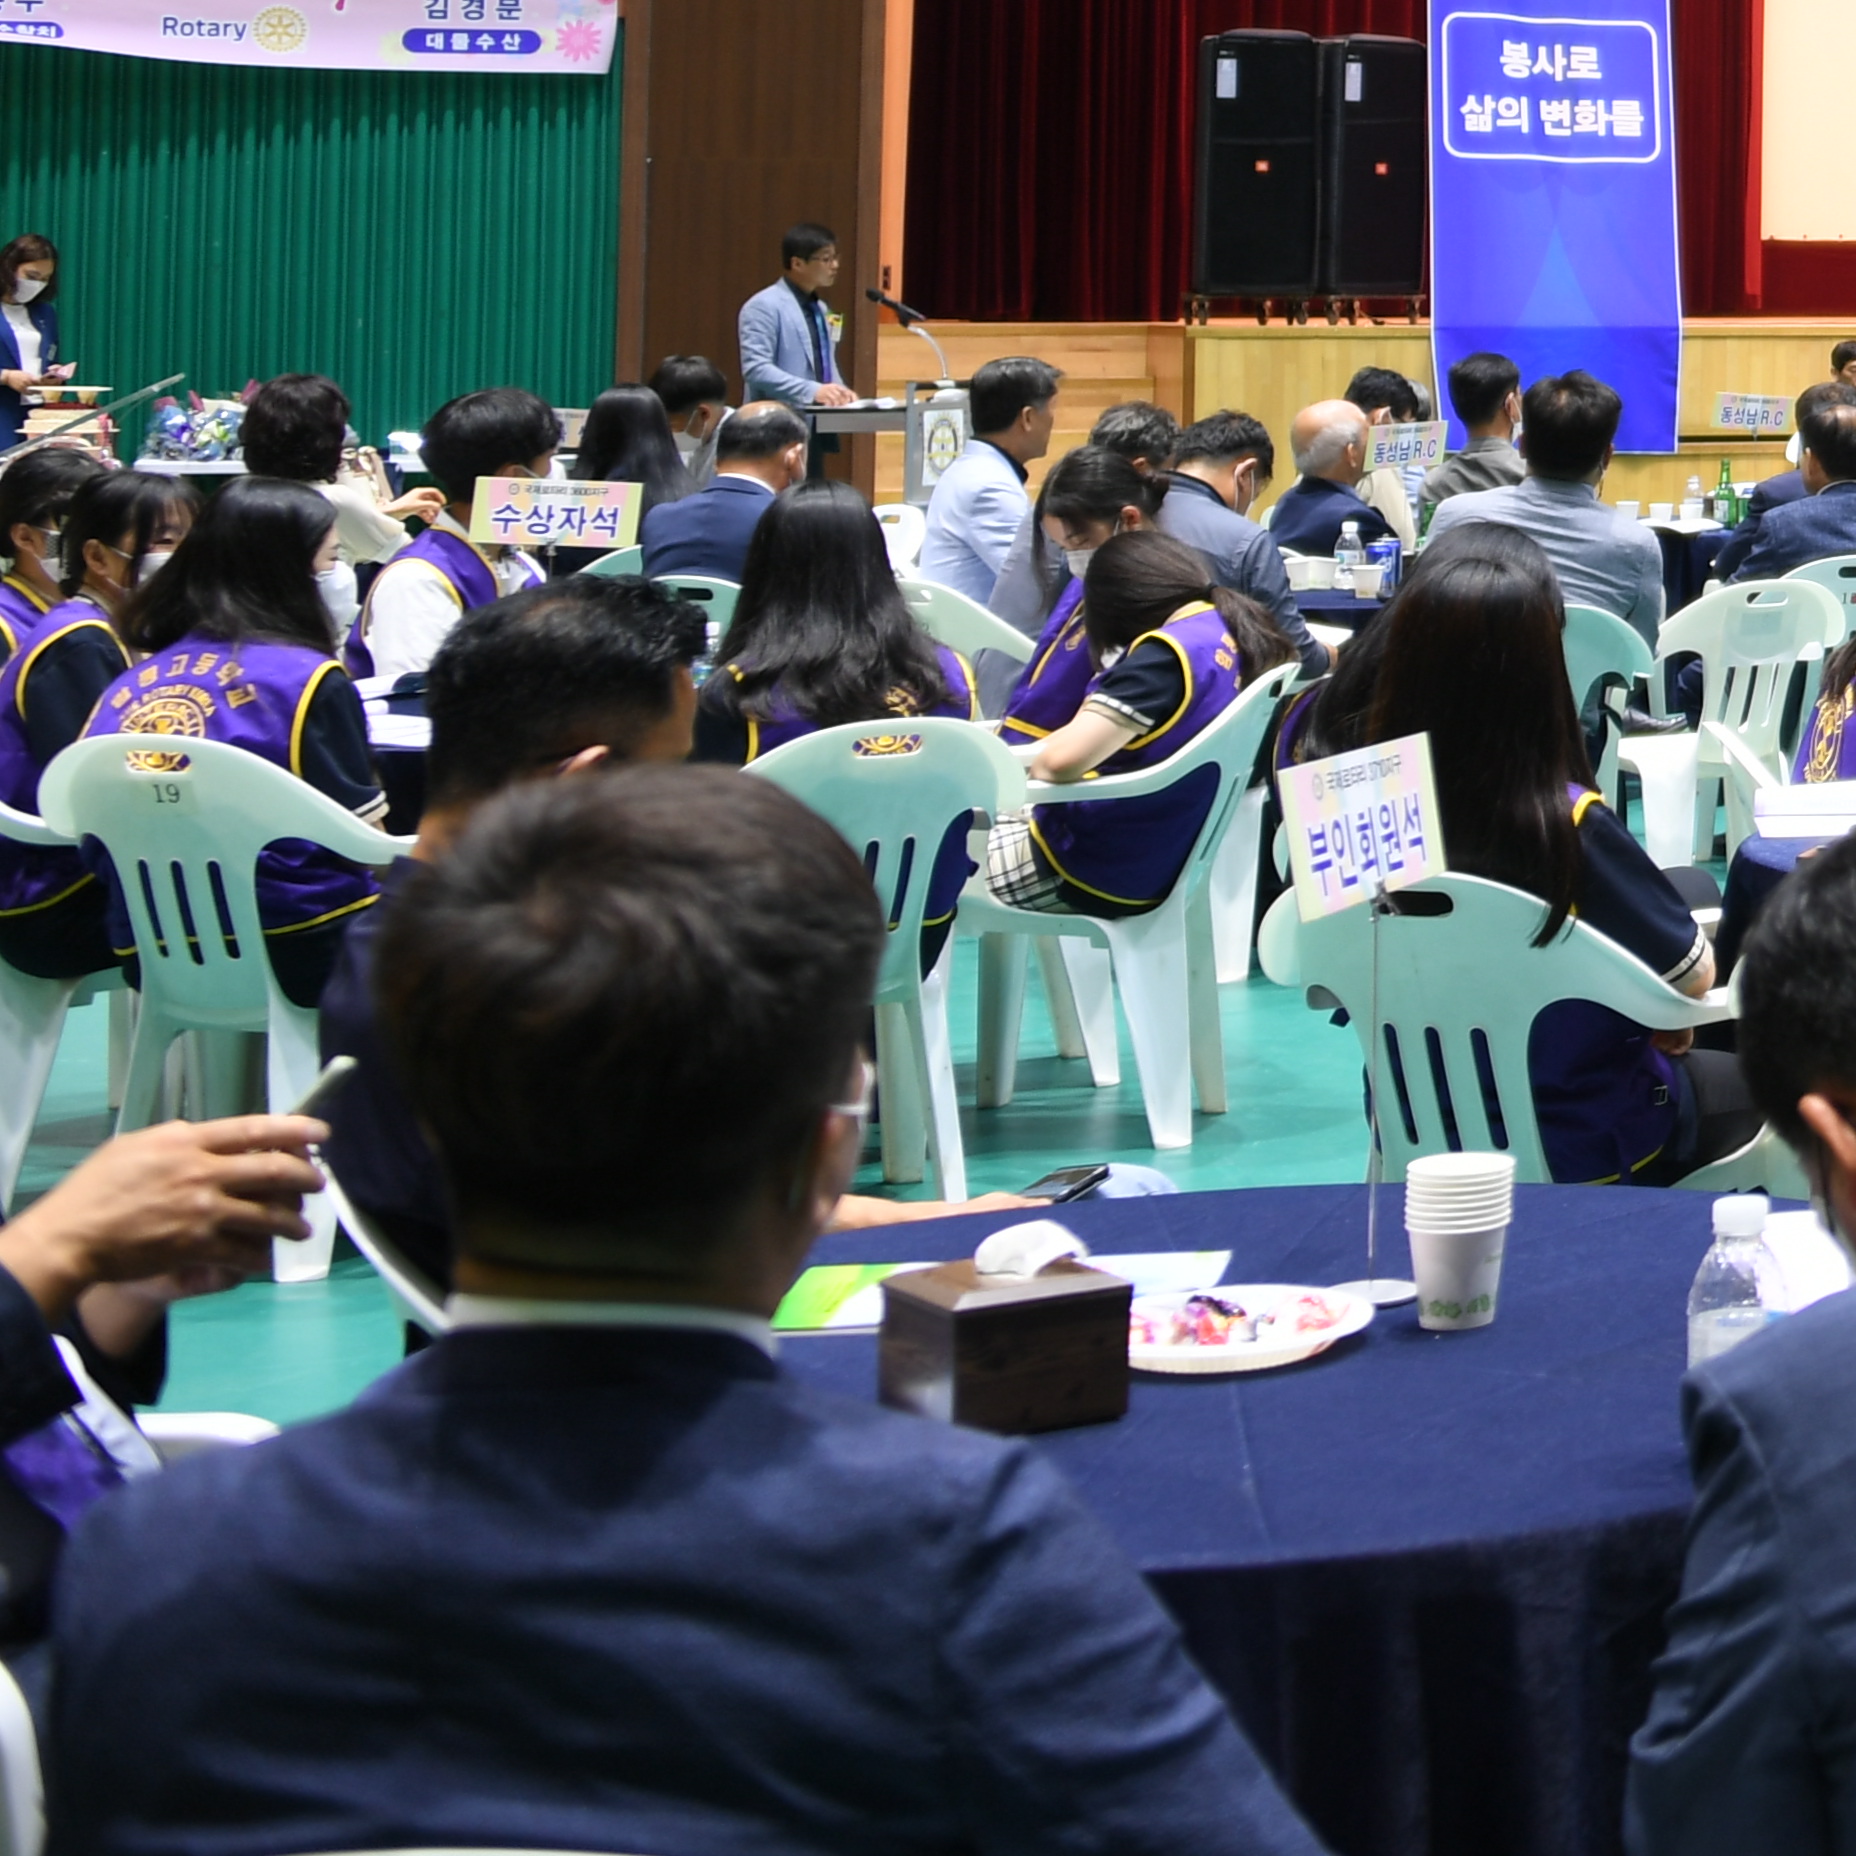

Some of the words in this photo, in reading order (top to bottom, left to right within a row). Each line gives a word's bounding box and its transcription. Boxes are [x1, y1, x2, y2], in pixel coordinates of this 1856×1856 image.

[162, 14, 248, 43] Rotary
[1500, 40, 1602, 82] 봉사로
[1460, 94, 1529, 133] 삶의
[1539, 99, 1644, 136] 변화를
[1720, 406, 1758, 425] 동성남
[1760, 409, 1784, 426] R.C
[1374, 440, 1411, 464] 동성남
[1413, 439, 1437, 459] R.C
[491, 503, 620, 538] 수상자석
[153, 783, 181, 804] 19
[1307, 793, 1426, 896] 부인회원석
